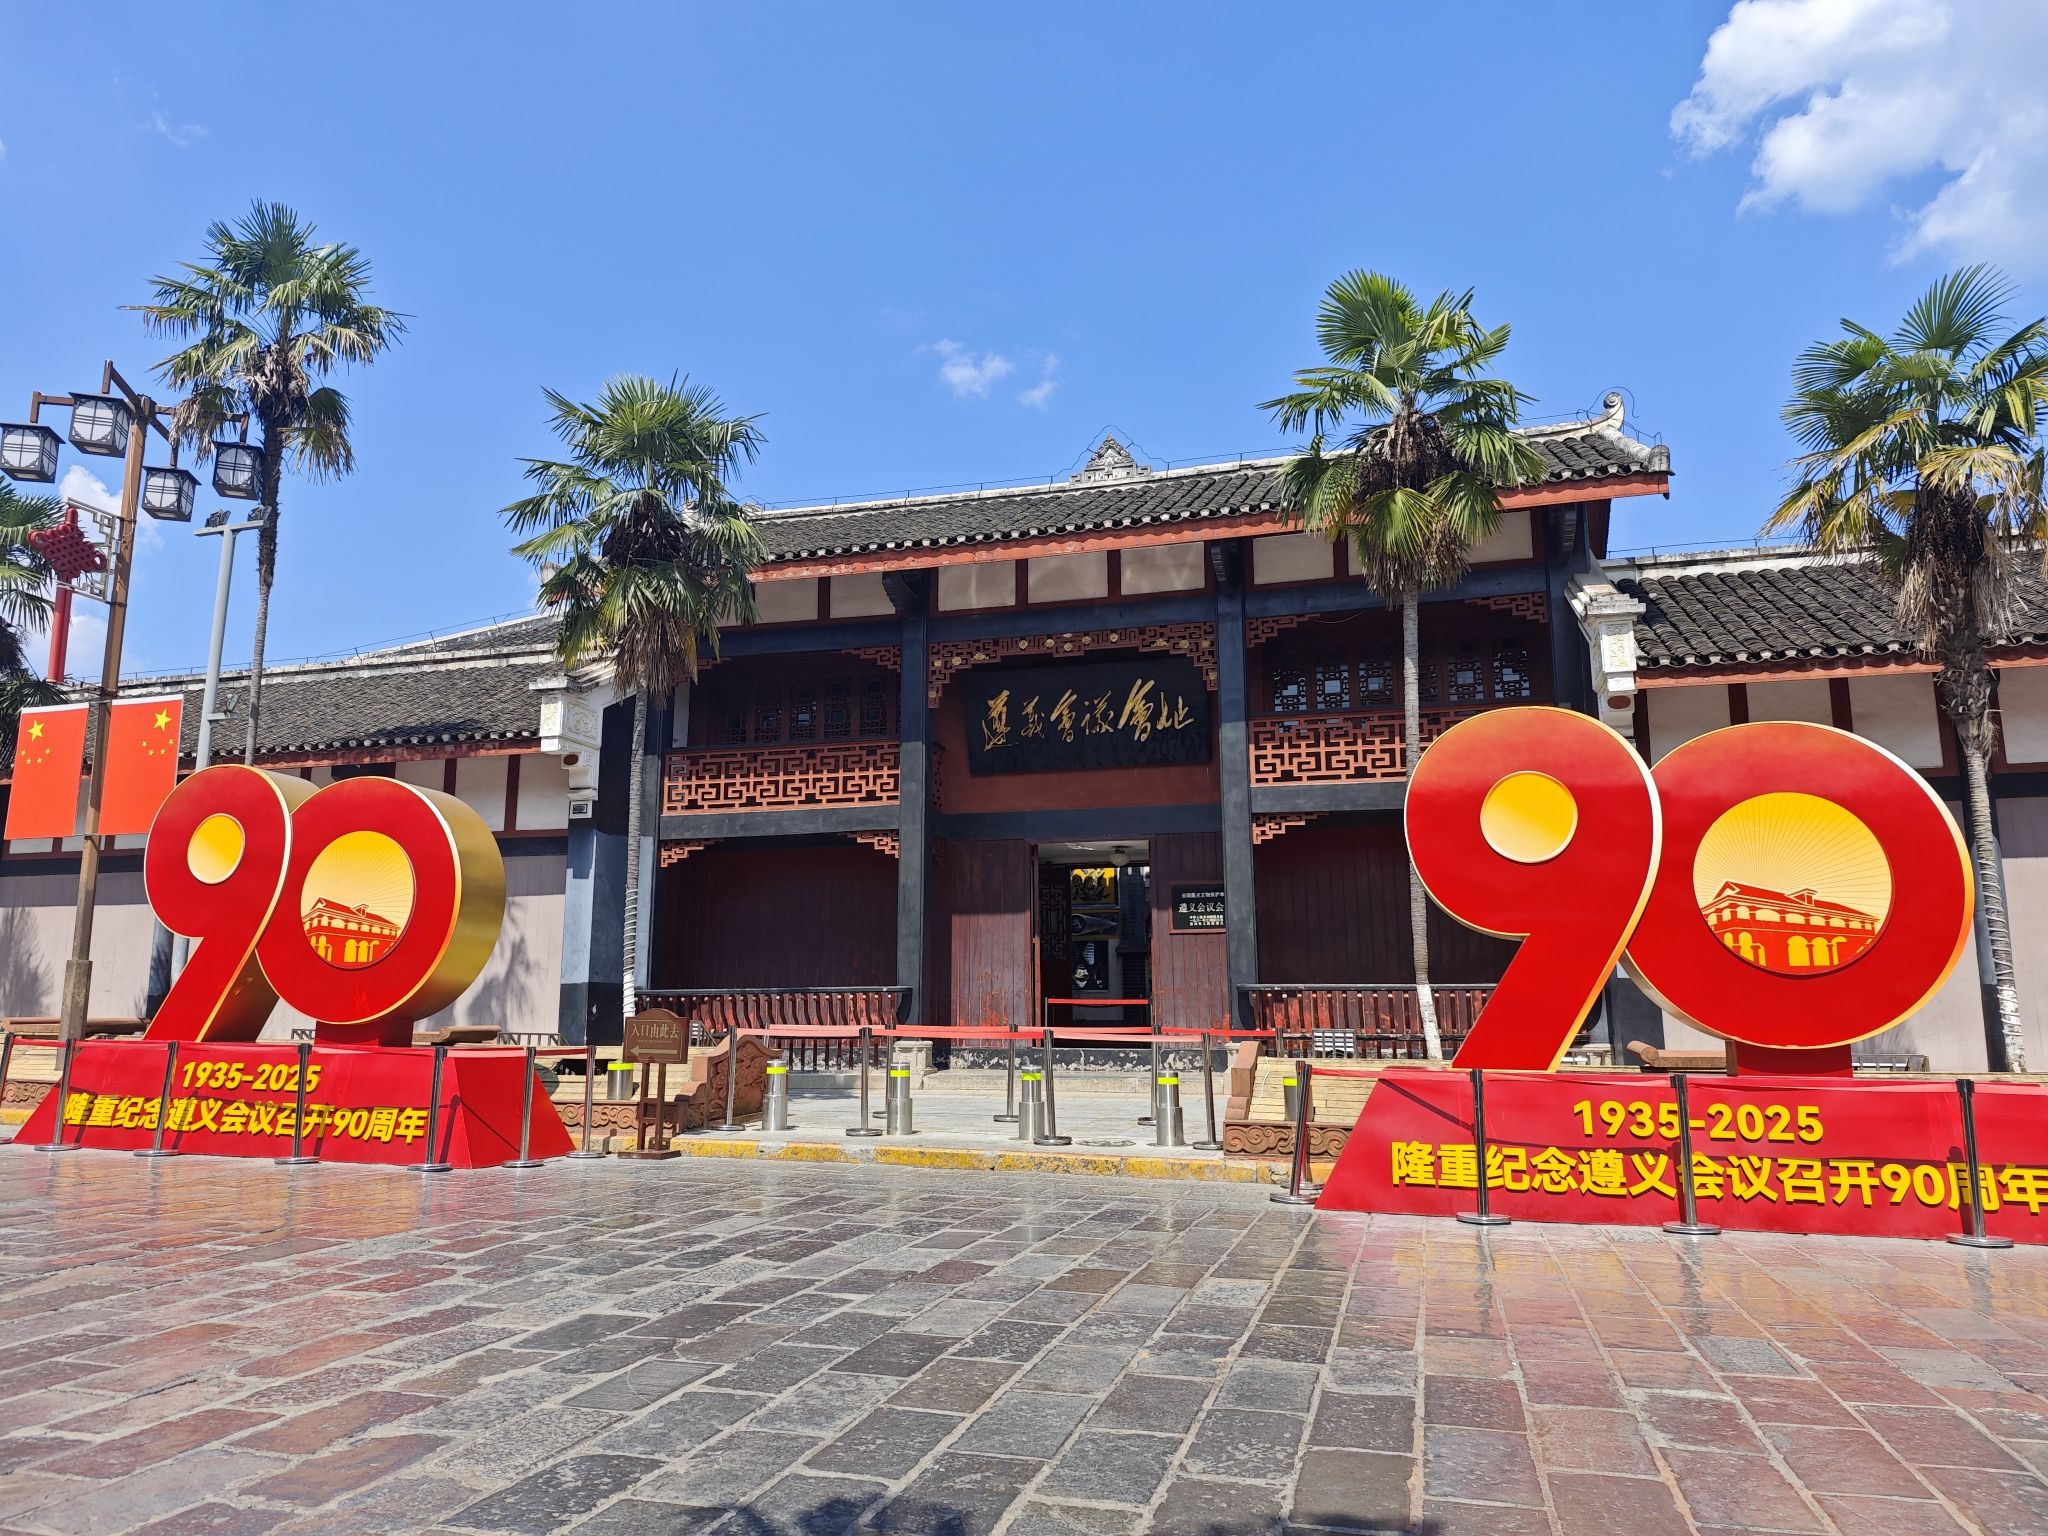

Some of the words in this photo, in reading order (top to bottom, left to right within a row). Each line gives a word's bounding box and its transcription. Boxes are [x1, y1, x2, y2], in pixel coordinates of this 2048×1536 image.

[631, 1023, 680, 1039] 入口由此去
[182, 1061, 321, 1093] 1935-2025
[63, 1092, 428, 1143] 隆重纪念遵义会议召开90周年
[1573, 1100, 1824, 1142] 1935-2025
[1391, 1141, 2048, 1214] 隆重纪念遵义会议召开90周年
